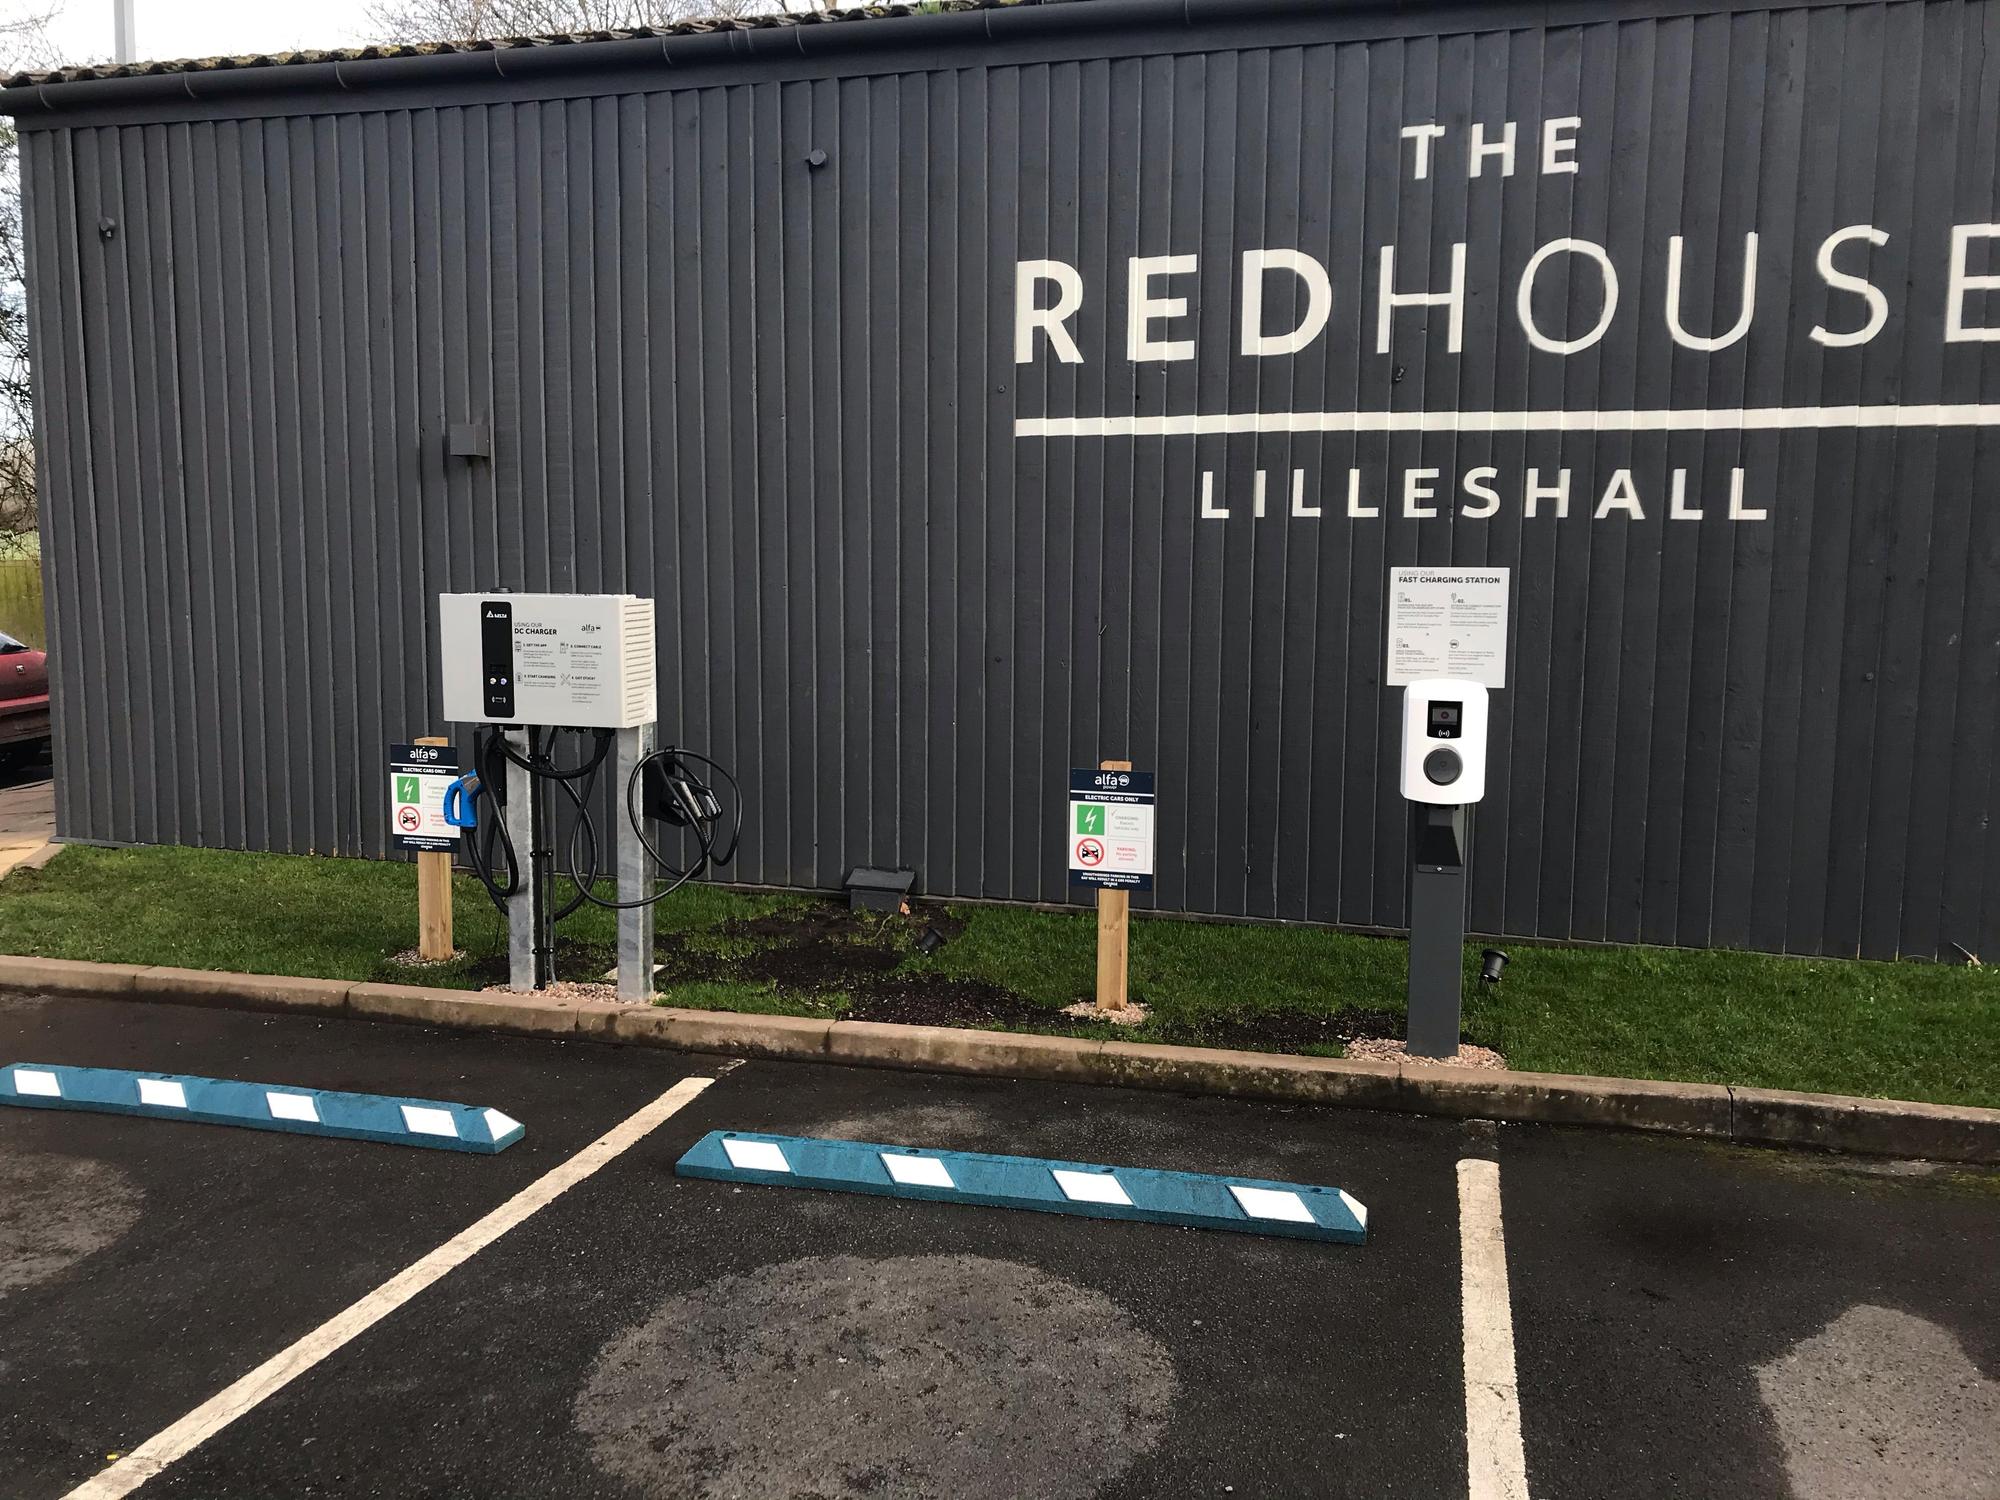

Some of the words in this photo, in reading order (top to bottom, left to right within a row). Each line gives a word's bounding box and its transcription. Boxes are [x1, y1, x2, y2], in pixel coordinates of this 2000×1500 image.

[1402, 116, 1581, 179] THE
[1202, 467, 1766, 520] LILLESHALL
[410, 748, 429, 759] alfa
[1095, 774, 1118, 786] alfa
